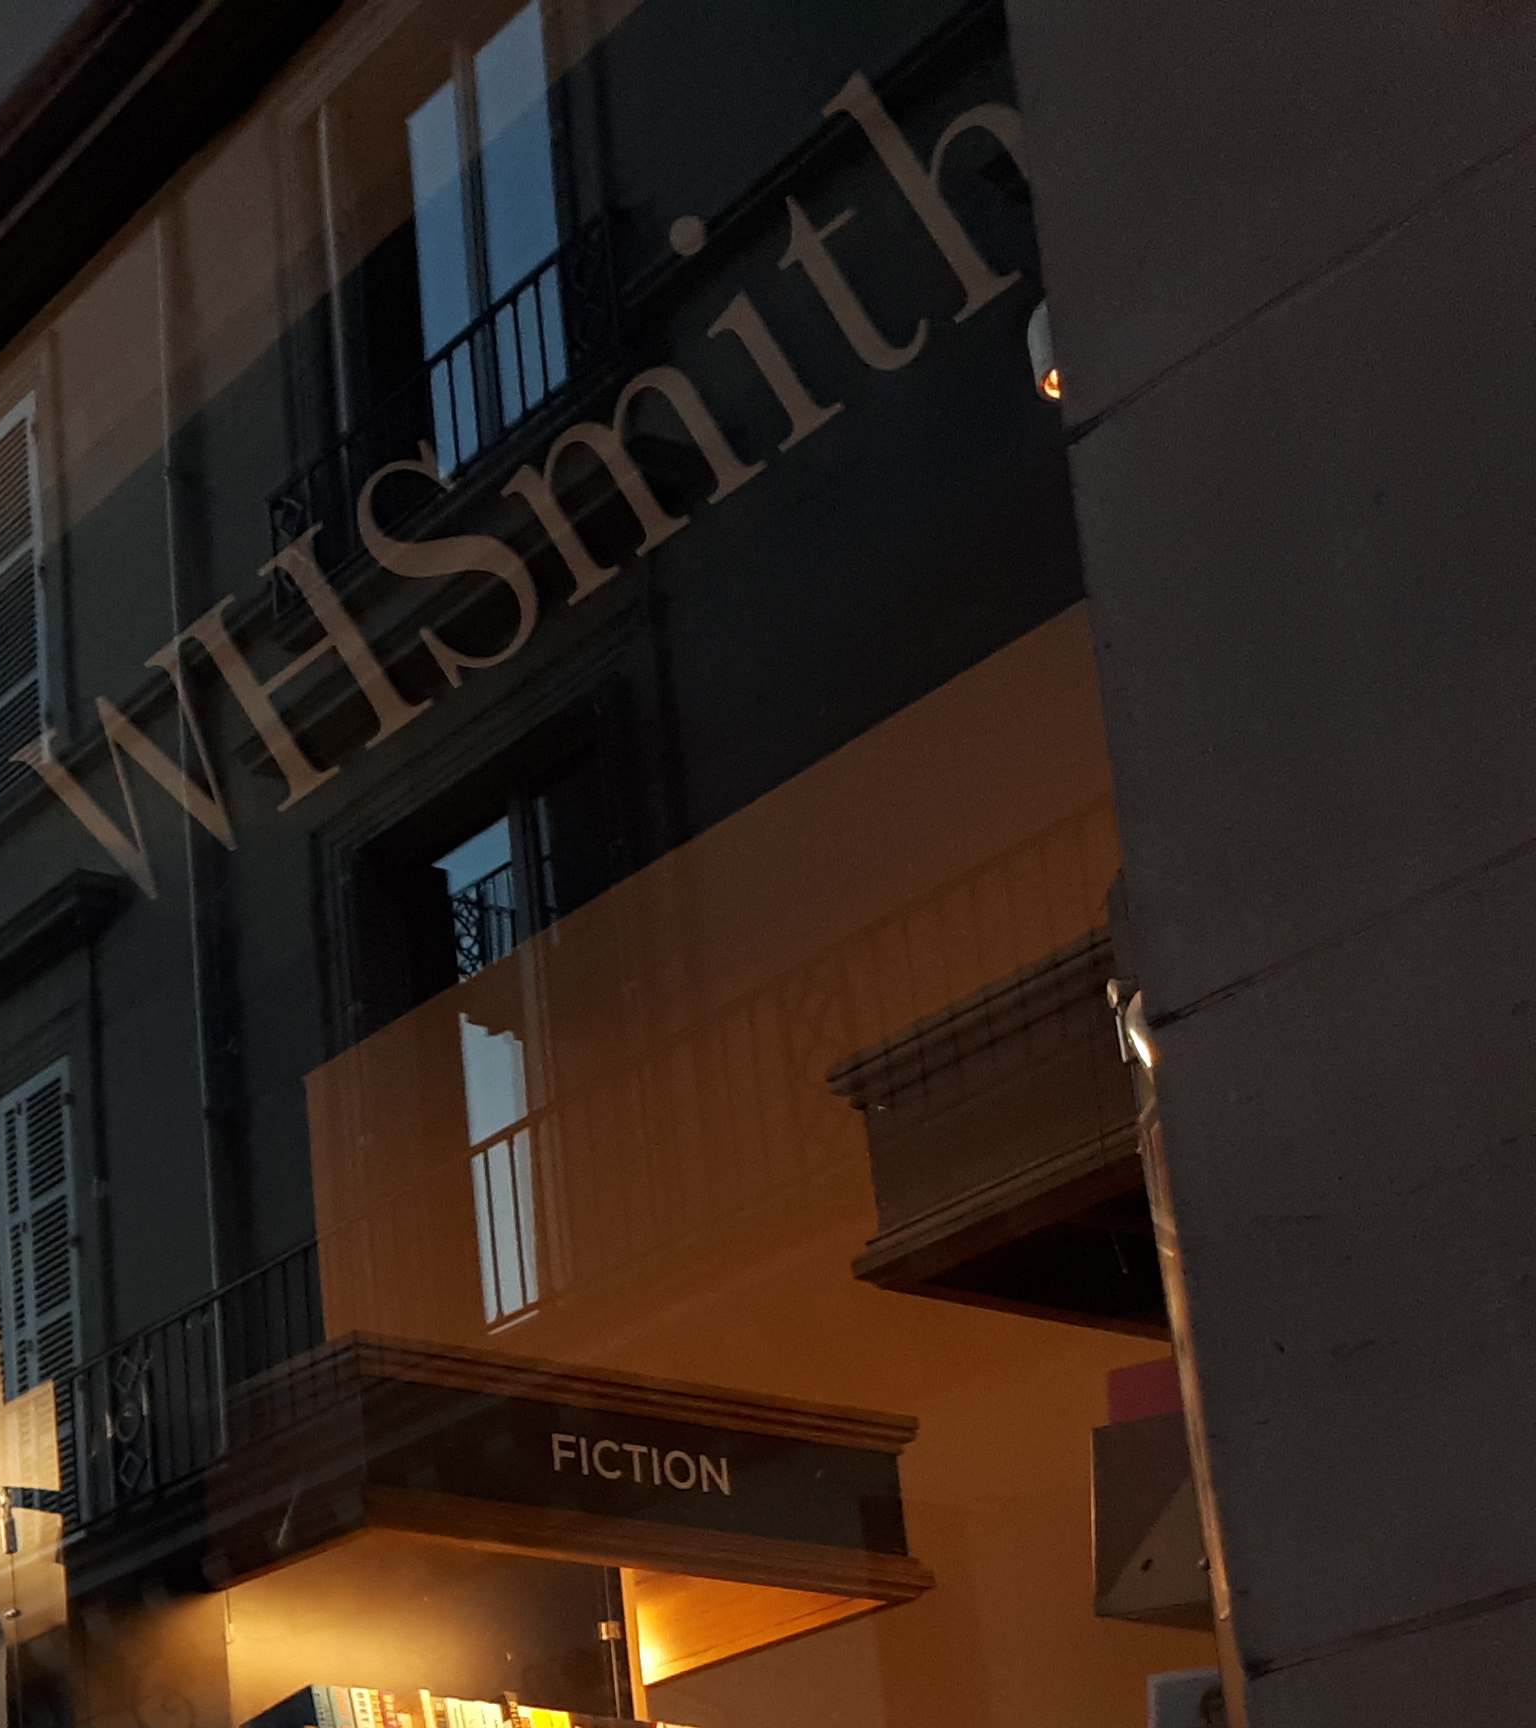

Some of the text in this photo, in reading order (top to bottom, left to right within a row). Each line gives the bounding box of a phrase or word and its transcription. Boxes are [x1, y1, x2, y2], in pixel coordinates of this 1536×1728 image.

[9, 70, 1025, 901] WHSmith
[551, 1432, 732, 1497] FICTION
[356, 1691, 369, 1724] BRET
